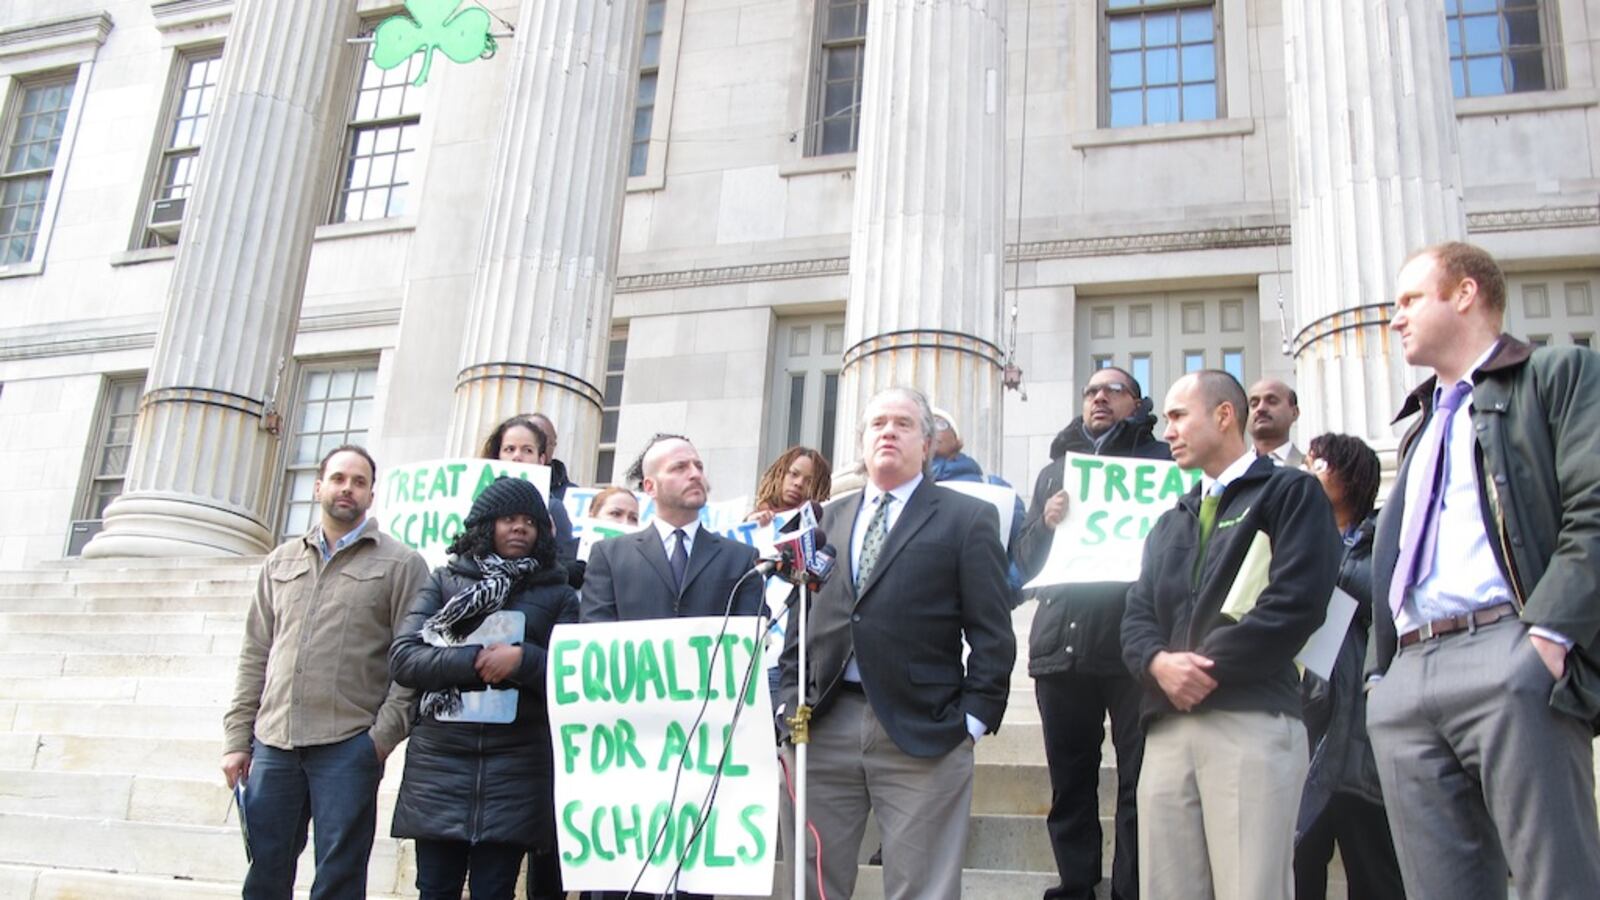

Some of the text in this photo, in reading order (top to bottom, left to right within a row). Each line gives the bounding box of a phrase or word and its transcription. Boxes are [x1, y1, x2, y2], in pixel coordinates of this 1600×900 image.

[385, 463, 467, 509] TREAT
[391, 511, 465, 549] SCHO
[554, 634, 764, 705] EQUALITY
[561, 719, 749, 776] FOR ALL
[563, 800, 767, 871] SCHOOLS
